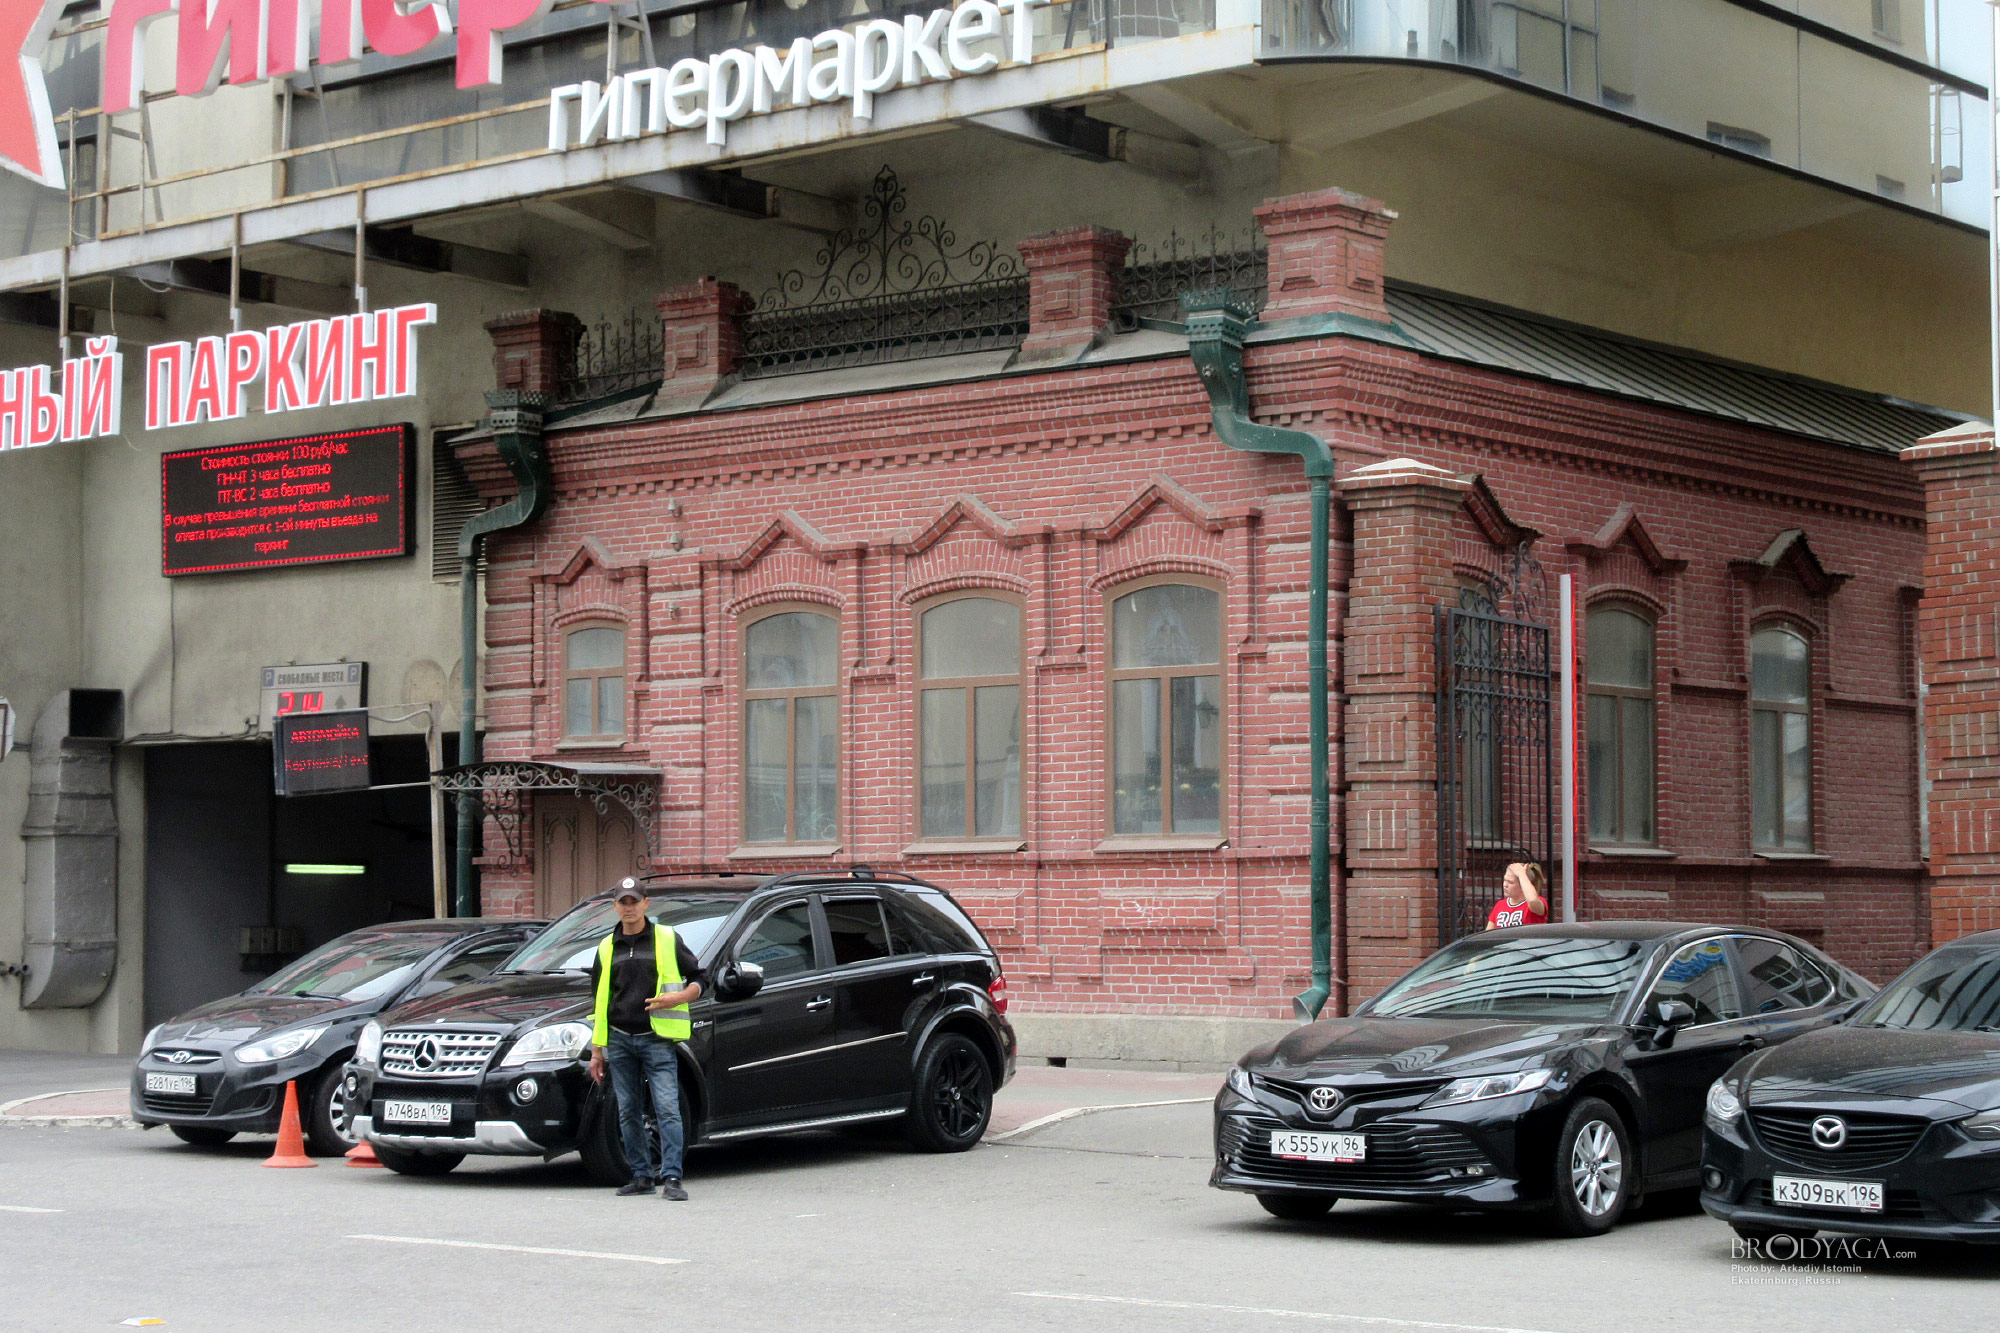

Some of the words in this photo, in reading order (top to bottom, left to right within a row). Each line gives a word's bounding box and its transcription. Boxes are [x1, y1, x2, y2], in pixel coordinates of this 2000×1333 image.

[548, 0, 1050, 152] гипермаркет
[145, 302, 437, 430] ПАРКИНГ
[201, 455, 250, 470] Стоимость
[292, 446, 310, 460] 100
[250, 470, 258, 483] 3
[258, 470, 280, 482] часа
[281, 463, 332, 481] бесплатно
[250, 488, 257, 502] 2
[258, 488, 280, 501] часа
[281, 481, 332, 500] бесплатно
[278, 672, 320, 685] СВОБОДНЫЕ
[322, 671, 344, 683] МЕСТА
[388, 1104, 427, 1119] А748ВА
[430, 1104, 448, 1116] 196
[1278, 1136, 1339, 1154] К555УК
[1344, 1137, 1359, 1151] 96
[1779, 1182, 1846, 1204] К309ВК
[1850, 1186, 1878, 1201] 196
